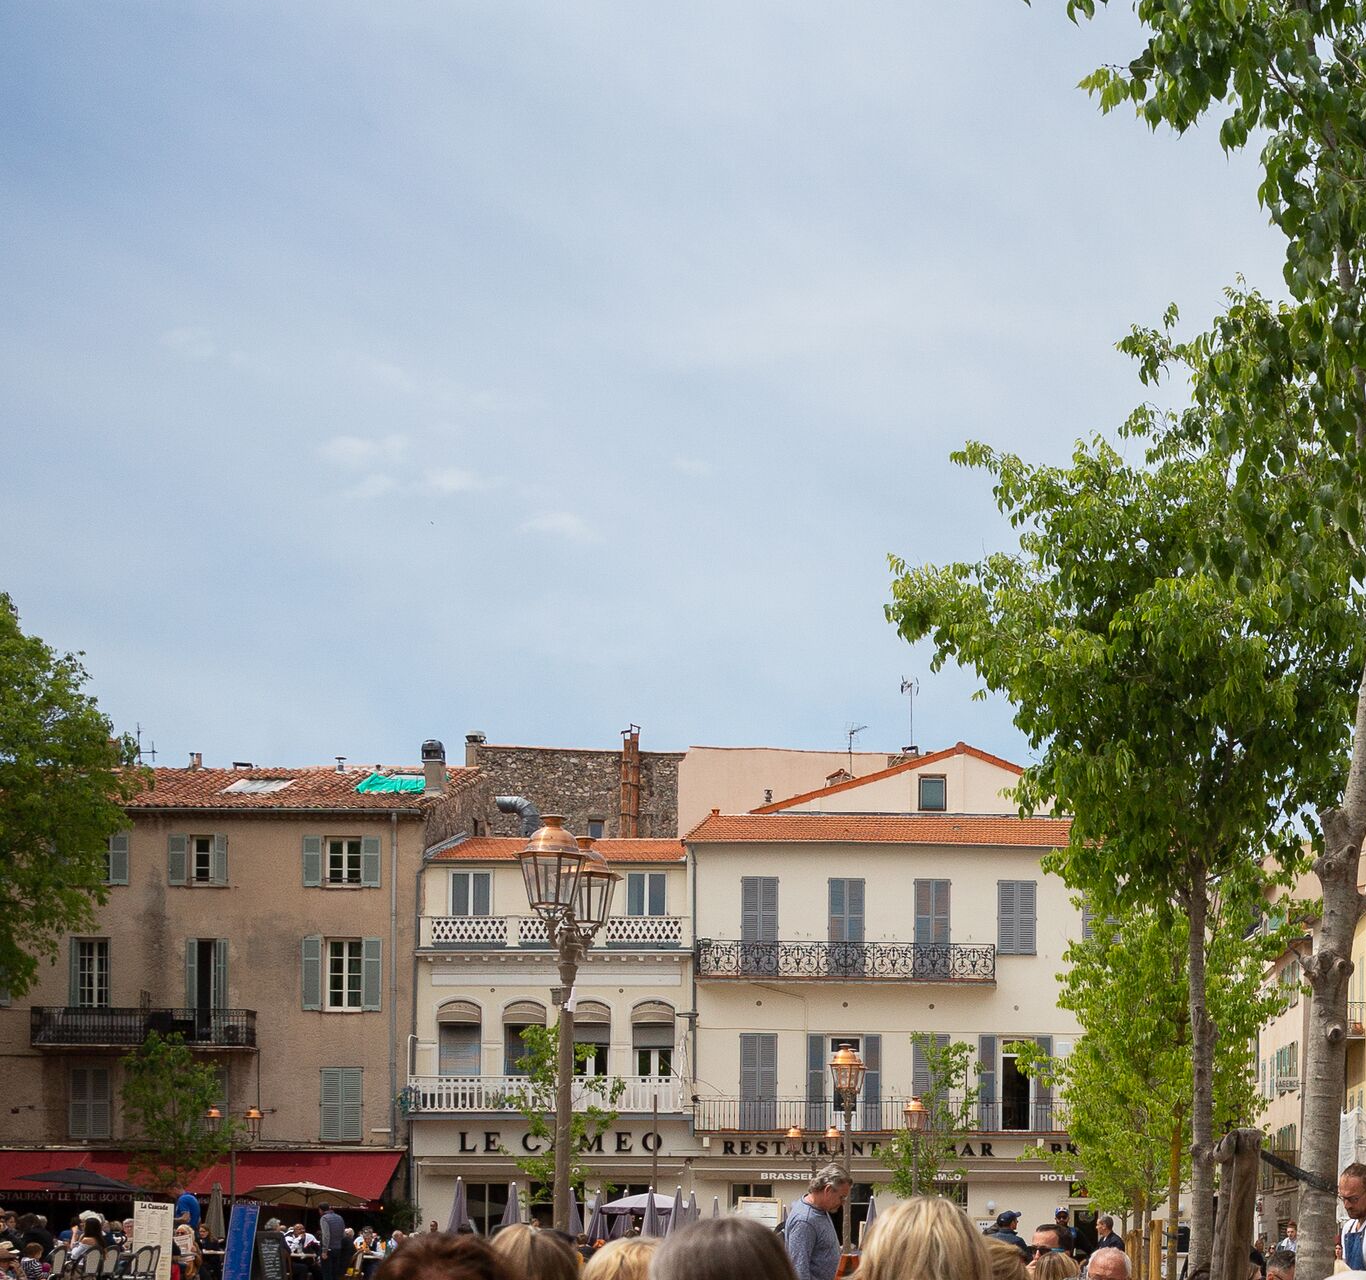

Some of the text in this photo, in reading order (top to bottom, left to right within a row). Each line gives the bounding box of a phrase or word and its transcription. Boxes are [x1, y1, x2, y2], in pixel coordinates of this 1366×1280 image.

[459, 1131, 663, 1153] LE CMEO
[1039, 1173, 1079, 1182] HOTEL
[57, 1192, 72, 1201] LE
[75, 1192, 97, 1202] TIRE
